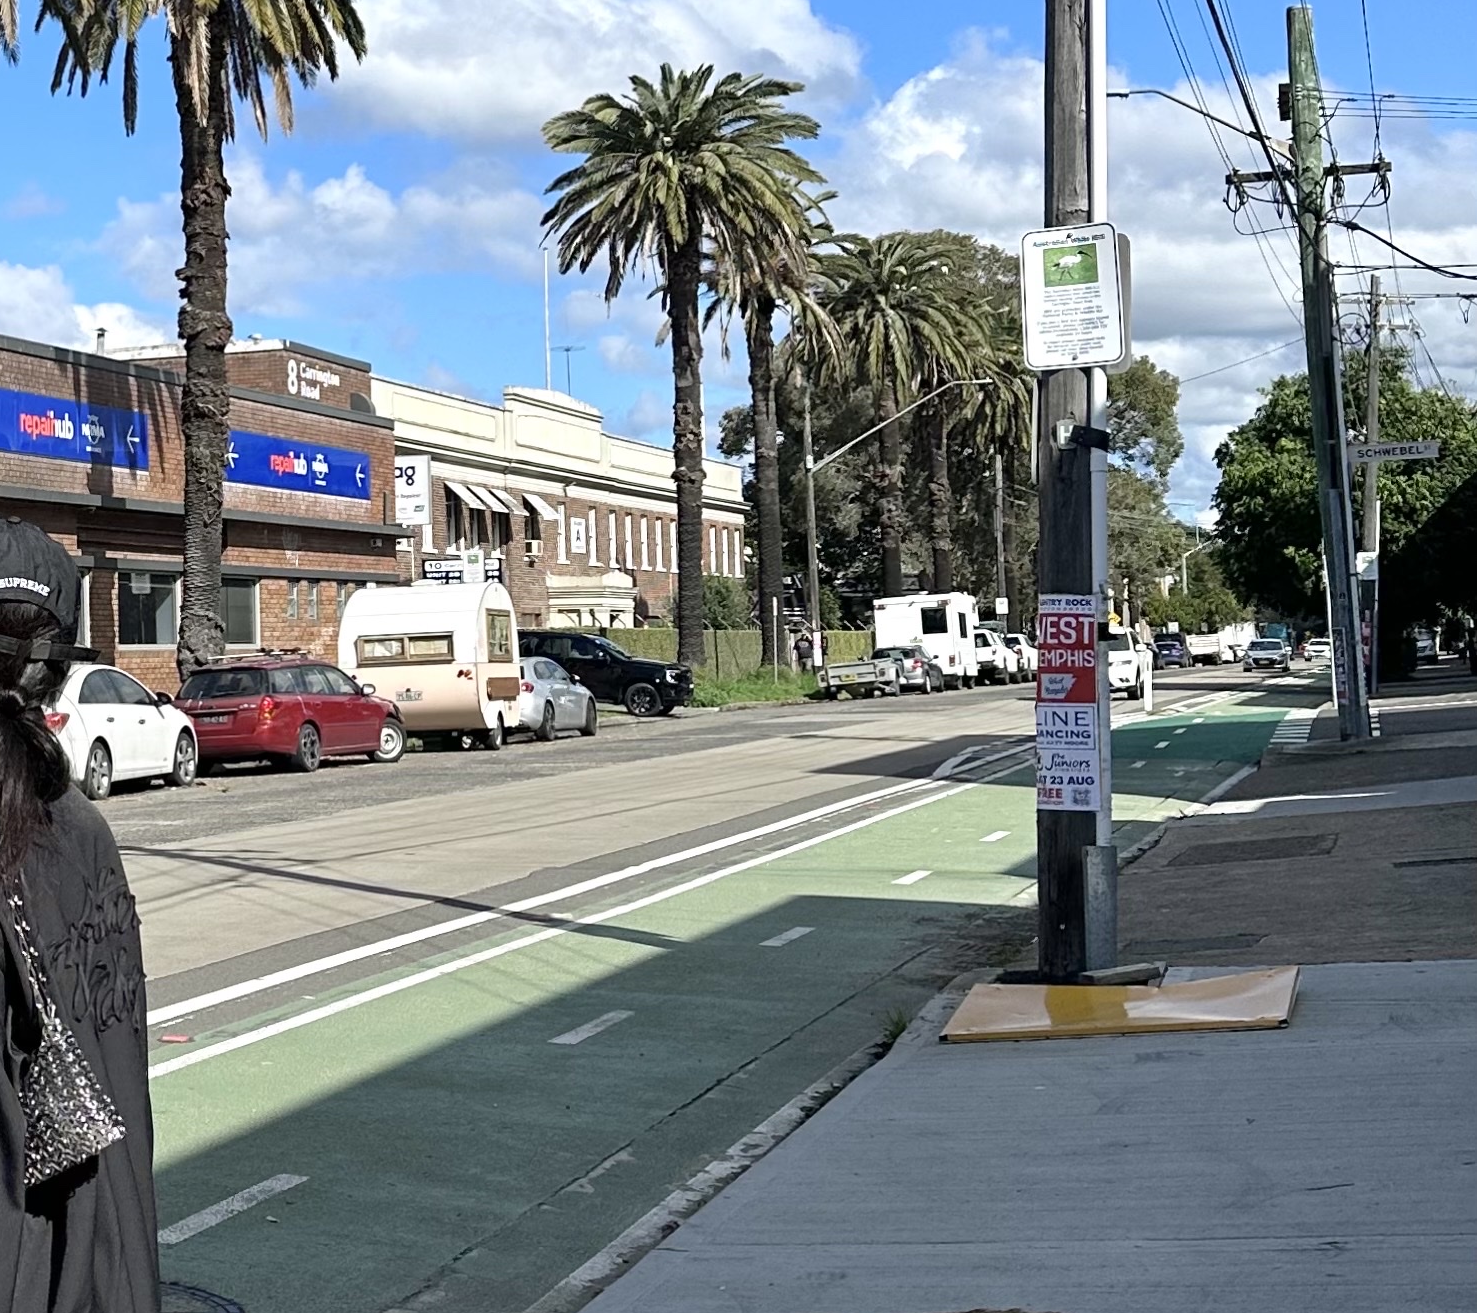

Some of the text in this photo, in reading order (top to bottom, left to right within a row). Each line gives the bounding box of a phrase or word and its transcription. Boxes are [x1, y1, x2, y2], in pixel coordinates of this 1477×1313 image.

[287, 358, 340, 395] 8 Carrington
[300, 380, 320, 400] Road
[1357, 445, 1423, 458] SCHWEBEL
[1037, 730, 1091, 739] ANCING
[1045, 754, 1091, 771] Juniors
[1050, 775, 1063, 785] 23
[1067, 776, 1095, 785] AUG
[1037, 788, 1063, 799] FREE
